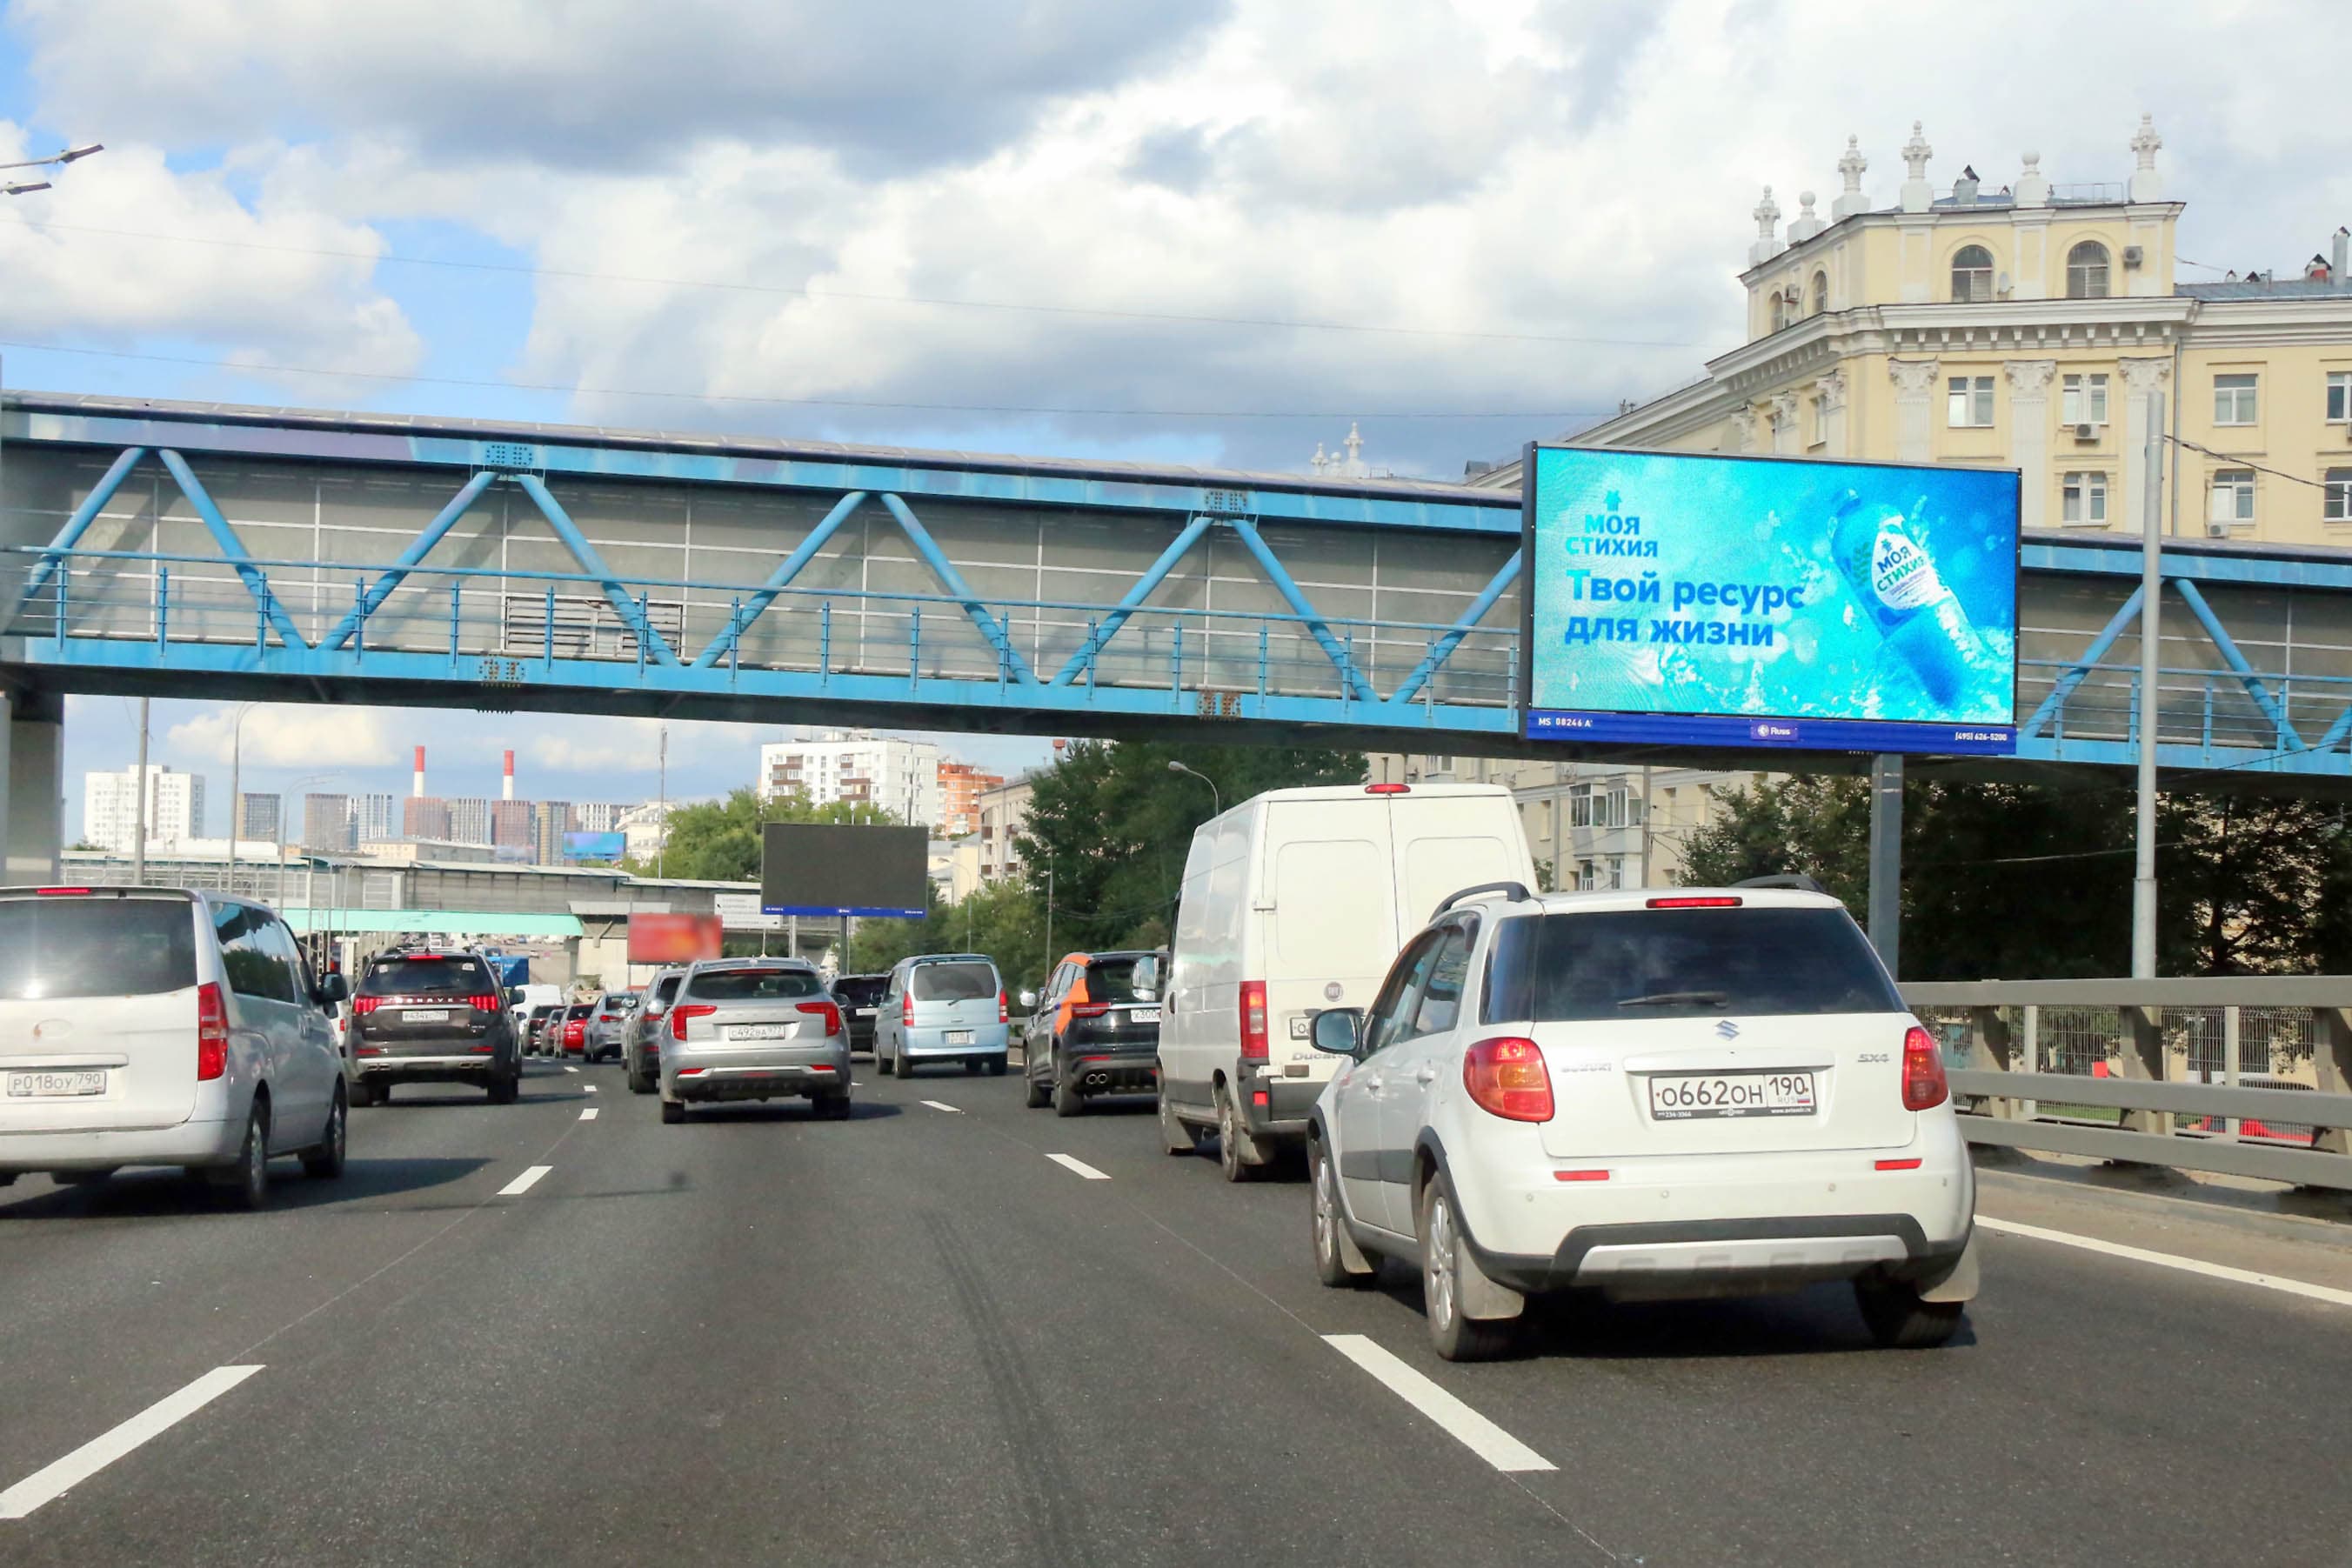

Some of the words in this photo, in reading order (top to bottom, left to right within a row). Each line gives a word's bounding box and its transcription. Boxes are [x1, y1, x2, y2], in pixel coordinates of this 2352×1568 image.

[1584, 514, 1640, 536] МОЯ
[1566, 537, 1659, 557] СТИХИЯ
[1877, 545, 1912, 574] МОЯ
[1567, 569, 1660, 604] Твой
[1674, 581, 1806, 616] ресурс
[1565, 617, 1639, 645] для
[1650, 619, 1774, 647] жизни
[1538, 717, 1552, 726] MS
[1292, 1052, 1338, 1061] Ducat
[1857, 1053, 1890, 1063] SX4
[1768, 1076, 1806, 1096] 190
